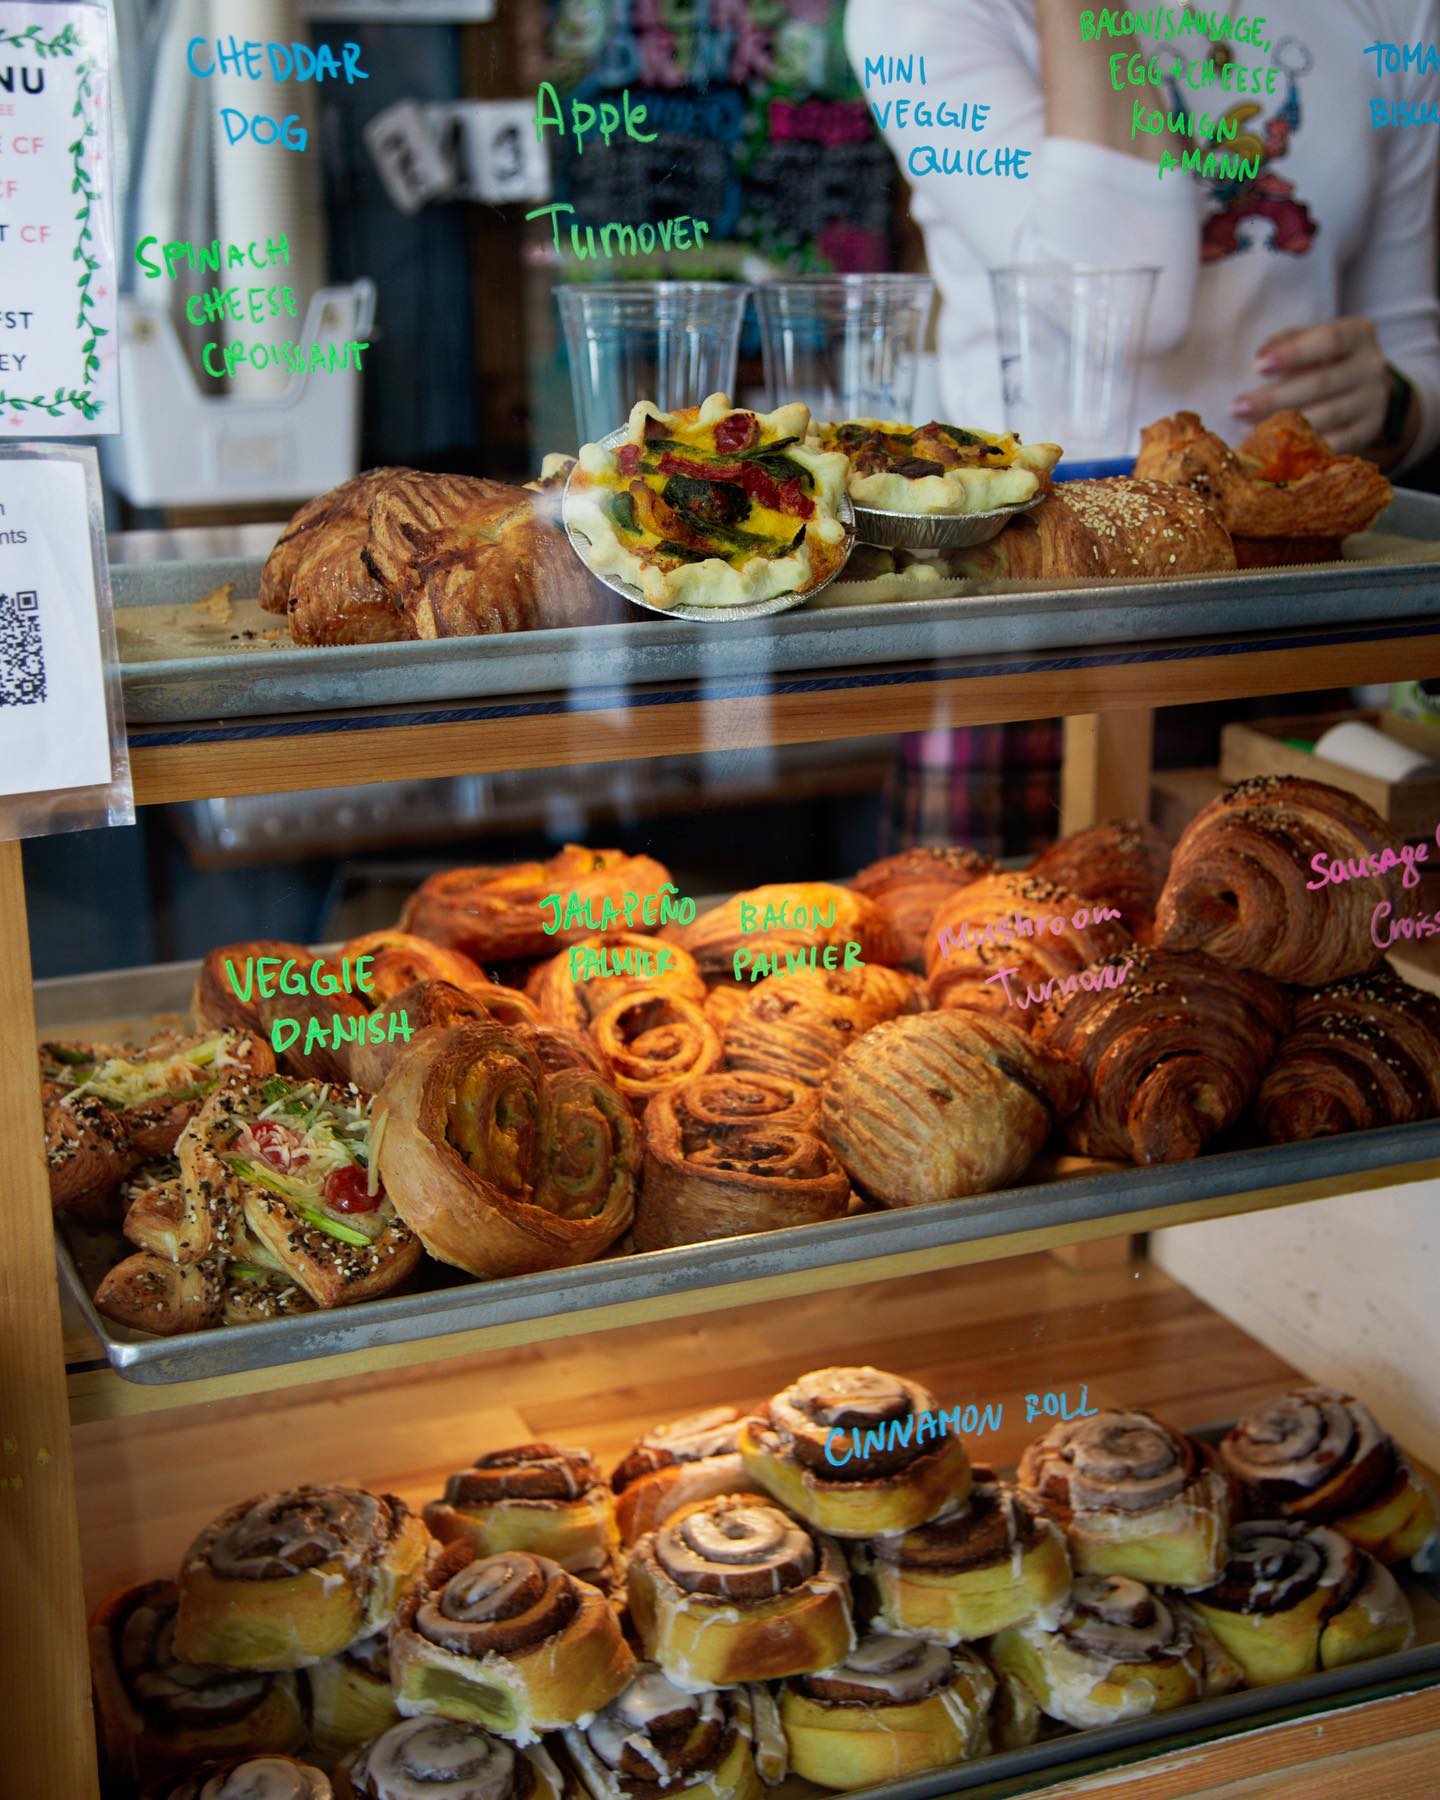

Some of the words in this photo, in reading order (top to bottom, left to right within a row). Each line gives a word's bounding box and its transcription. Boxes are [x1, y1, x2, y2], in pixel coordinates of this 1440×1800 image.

[187, 35, 369, 84] CHEDDAR
[865, 54, 926, 88] MINI
[220, 108, 308, 152] DOG
[534, 82, 658, 154] Apple
[872, 99, 991, 132] VEGGIE
[1131, 99, 1237, 142] KOUIGN
[12, 136, 44, 154] CF
[909, 146, 1032, 179] QUICHE
[1158, 148, 1260, 182] AMANN
[20, 225, 51, 243] CF
[135, 232, 290, 280] SPINACH
[186, 286, 298, 326] CHEESE
[203, 341, 370, 378] CROISSANT
[1306, 843, 1429, 890] Sausage
[539, 882, 696, 935] JALAPEÑO
[740, 899, 835, 934] BACON
[938, 906, 1121, 960] Mushroom
[225, 955, 376, 1003] VEGGIE
[568, 945, 676, 983] PALMIER
[732, 941, 866, 982] PALMIER
[270, 1009, 415, 1055] DANISH
[824, 1403, 1003, 1467] CINNAMON
